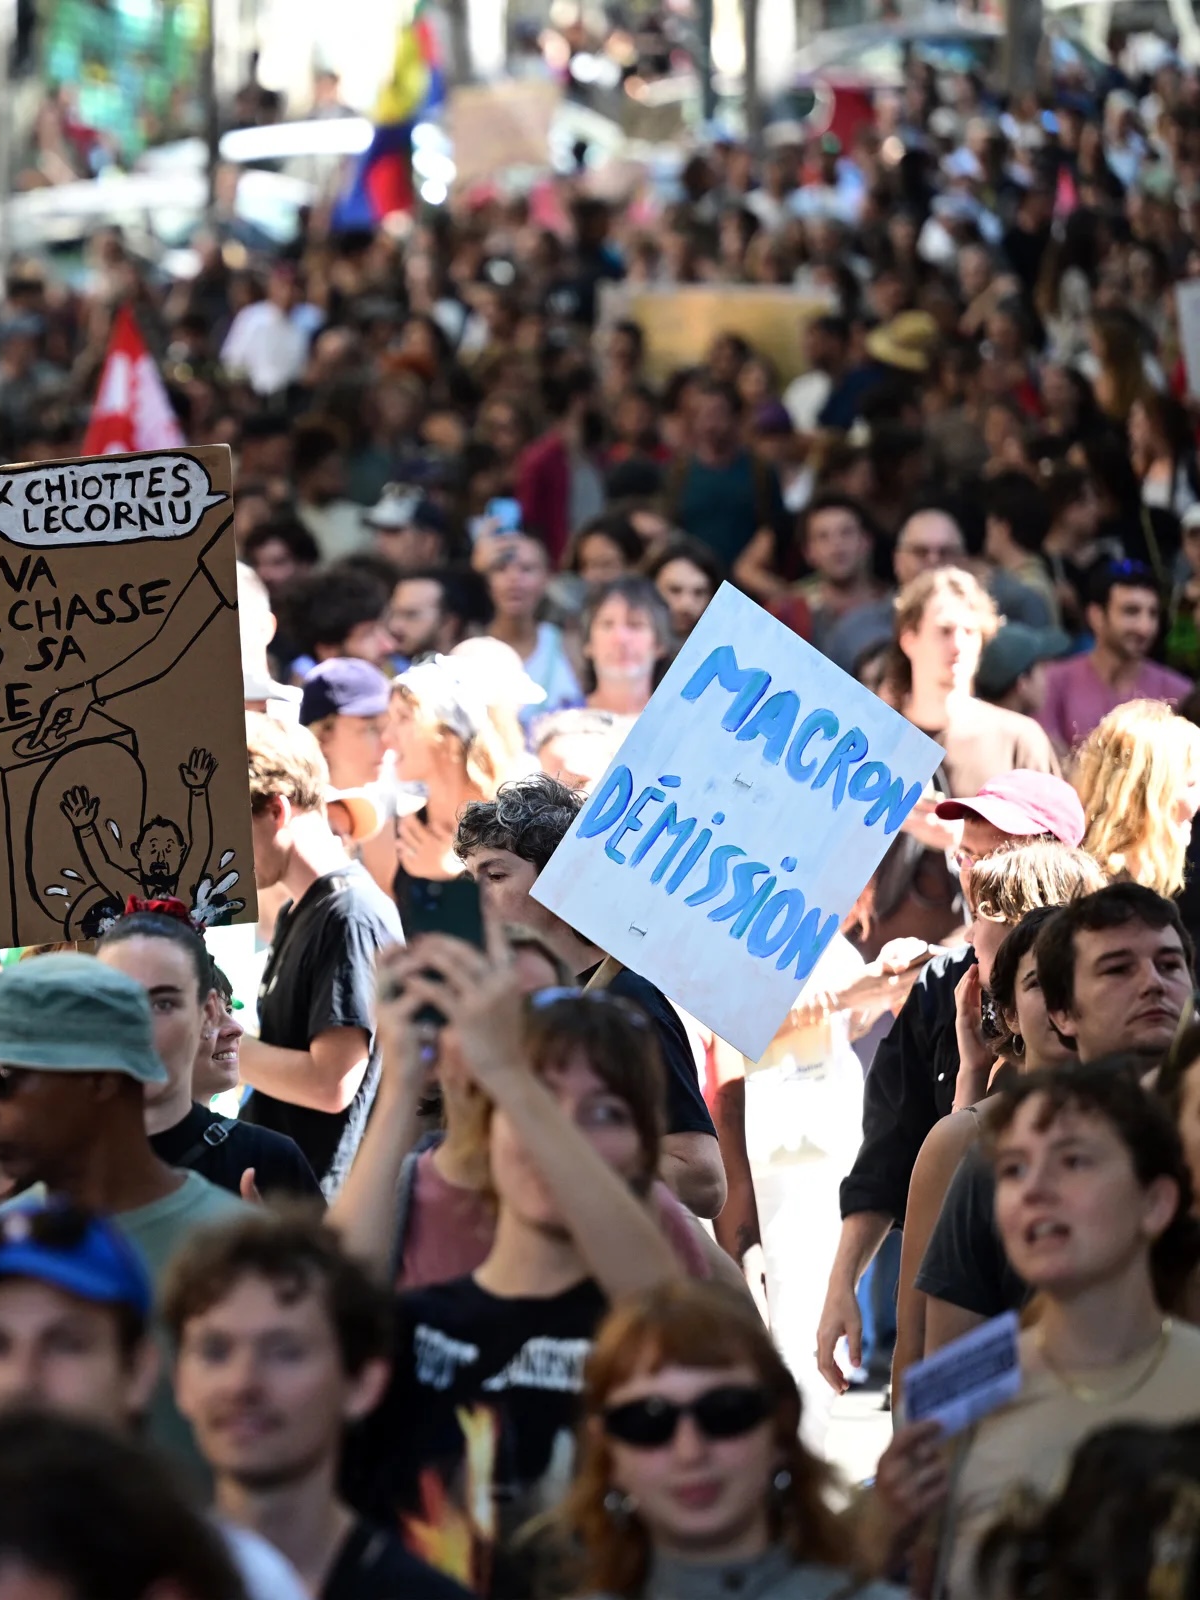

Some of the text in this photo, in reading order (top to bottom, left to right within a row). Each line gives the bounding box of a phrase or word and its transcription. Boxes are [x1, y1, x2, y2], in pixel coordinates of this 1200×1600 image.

[24, 463, 192, 505] CHiOTTES
[22, 500, 192, 534] LECORNU
[8, 579, 171, 633] CHASSE
[24, 635, 86, 671] SA
[680, 645, 922, 835] MACRON
[576, 764, 840, 981] DÉMiSSiON
